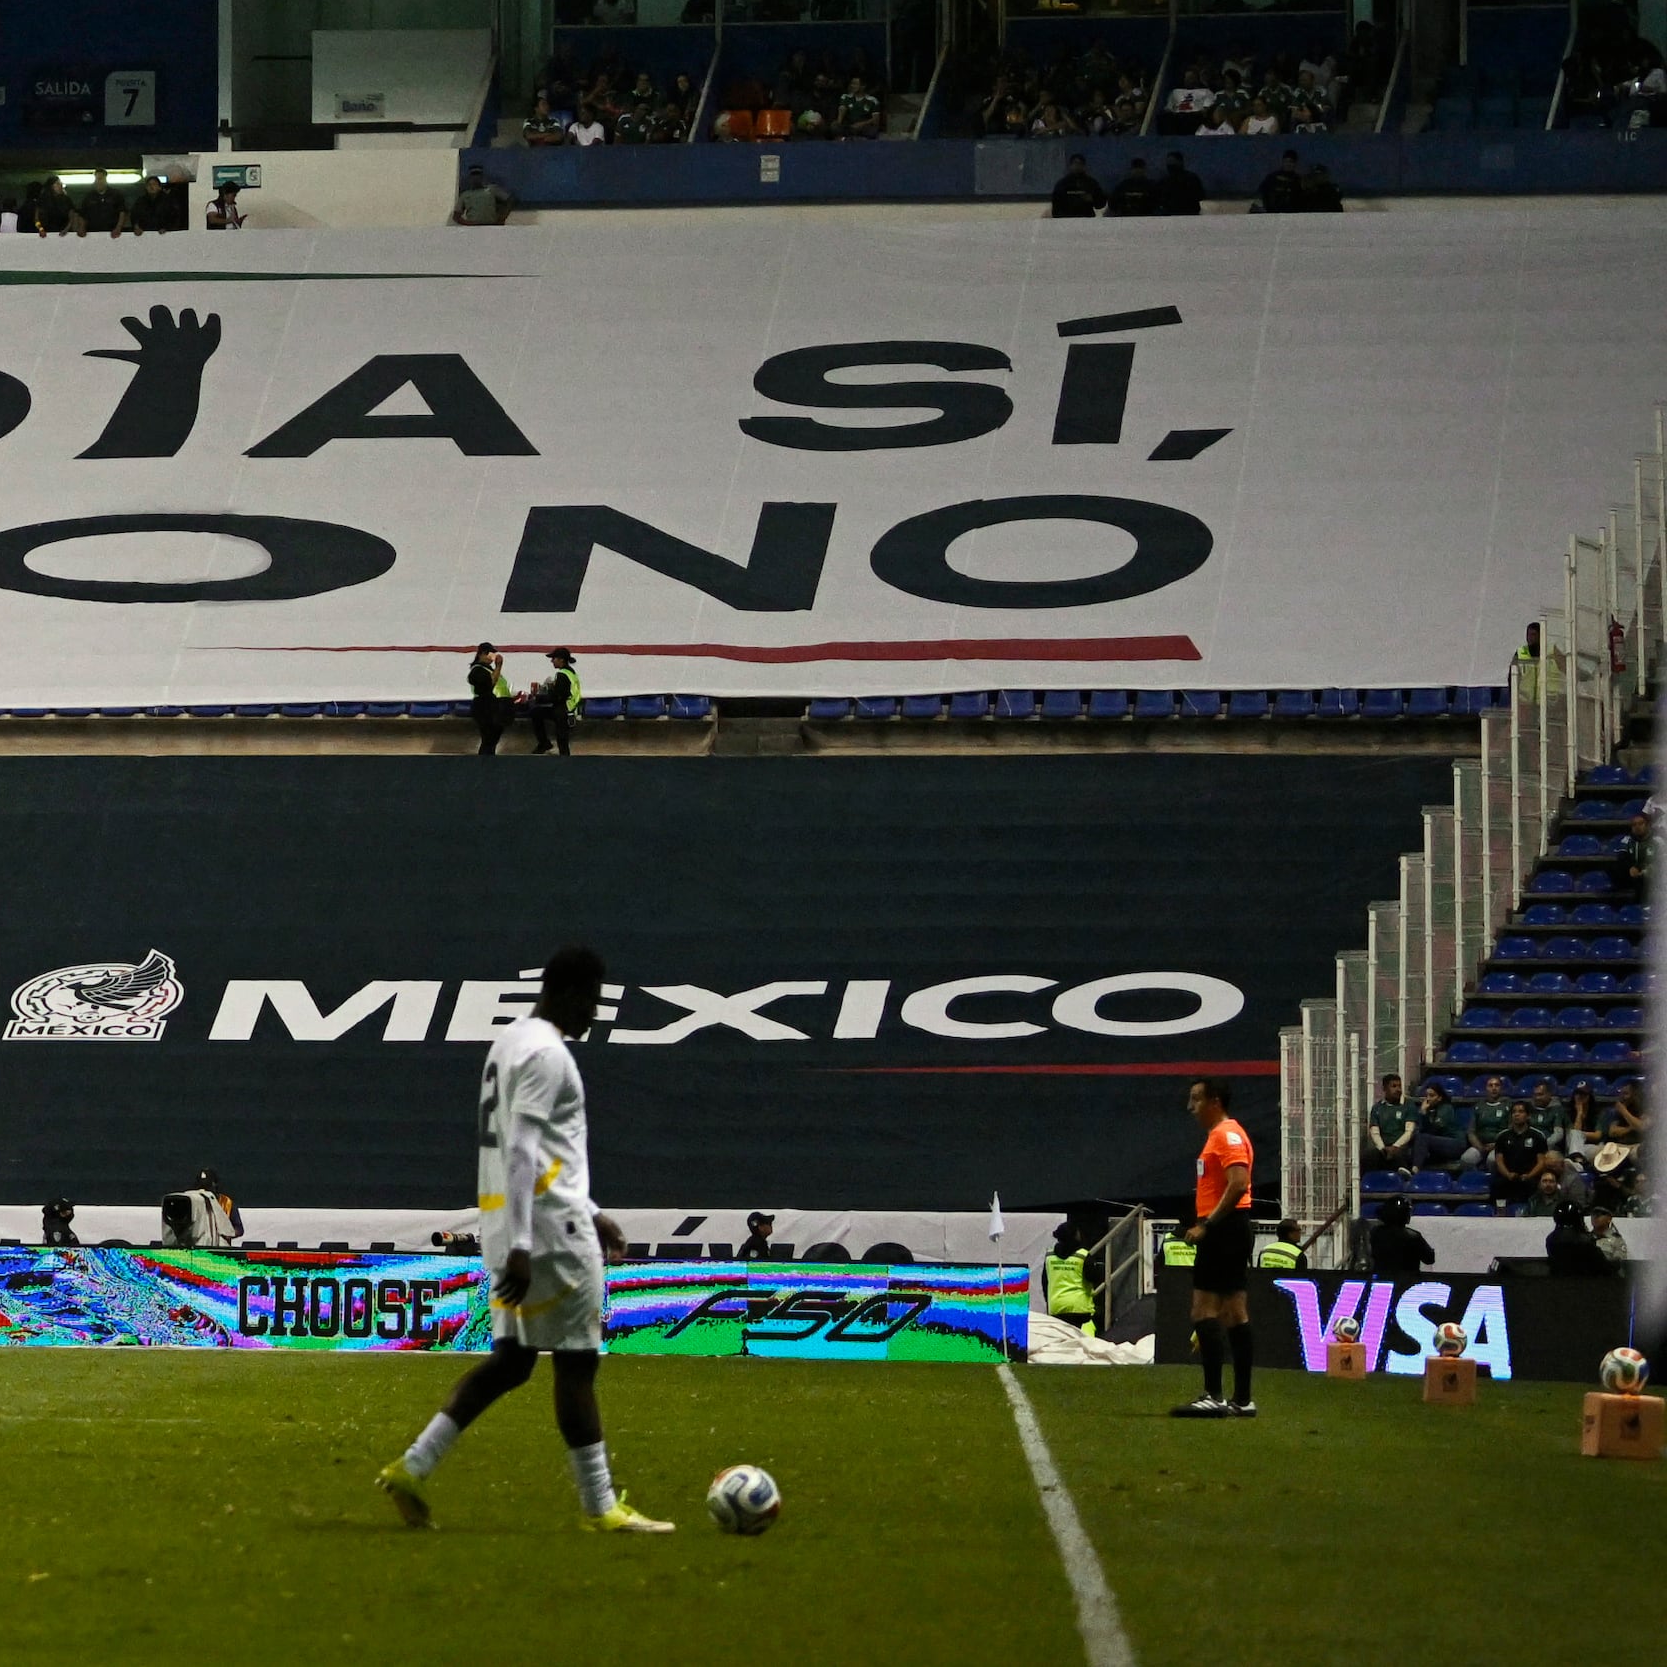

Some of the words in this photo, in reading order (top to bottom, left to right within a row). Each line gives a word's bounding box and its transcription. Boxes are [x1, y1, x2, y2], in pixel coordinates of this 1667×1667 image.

[35, 81, 92, 95] SALIDA
[122, 88, 140, 118] 7
[499, 494, 1215, 613] NO
[16, 1023, 152, 1036] MÉXICO
[207, 964, 1247, 1045] MÉXICO
[235, 1275, 444, 1339] CHOOSE
[1273, 1275, 1513, 1380] VISA
